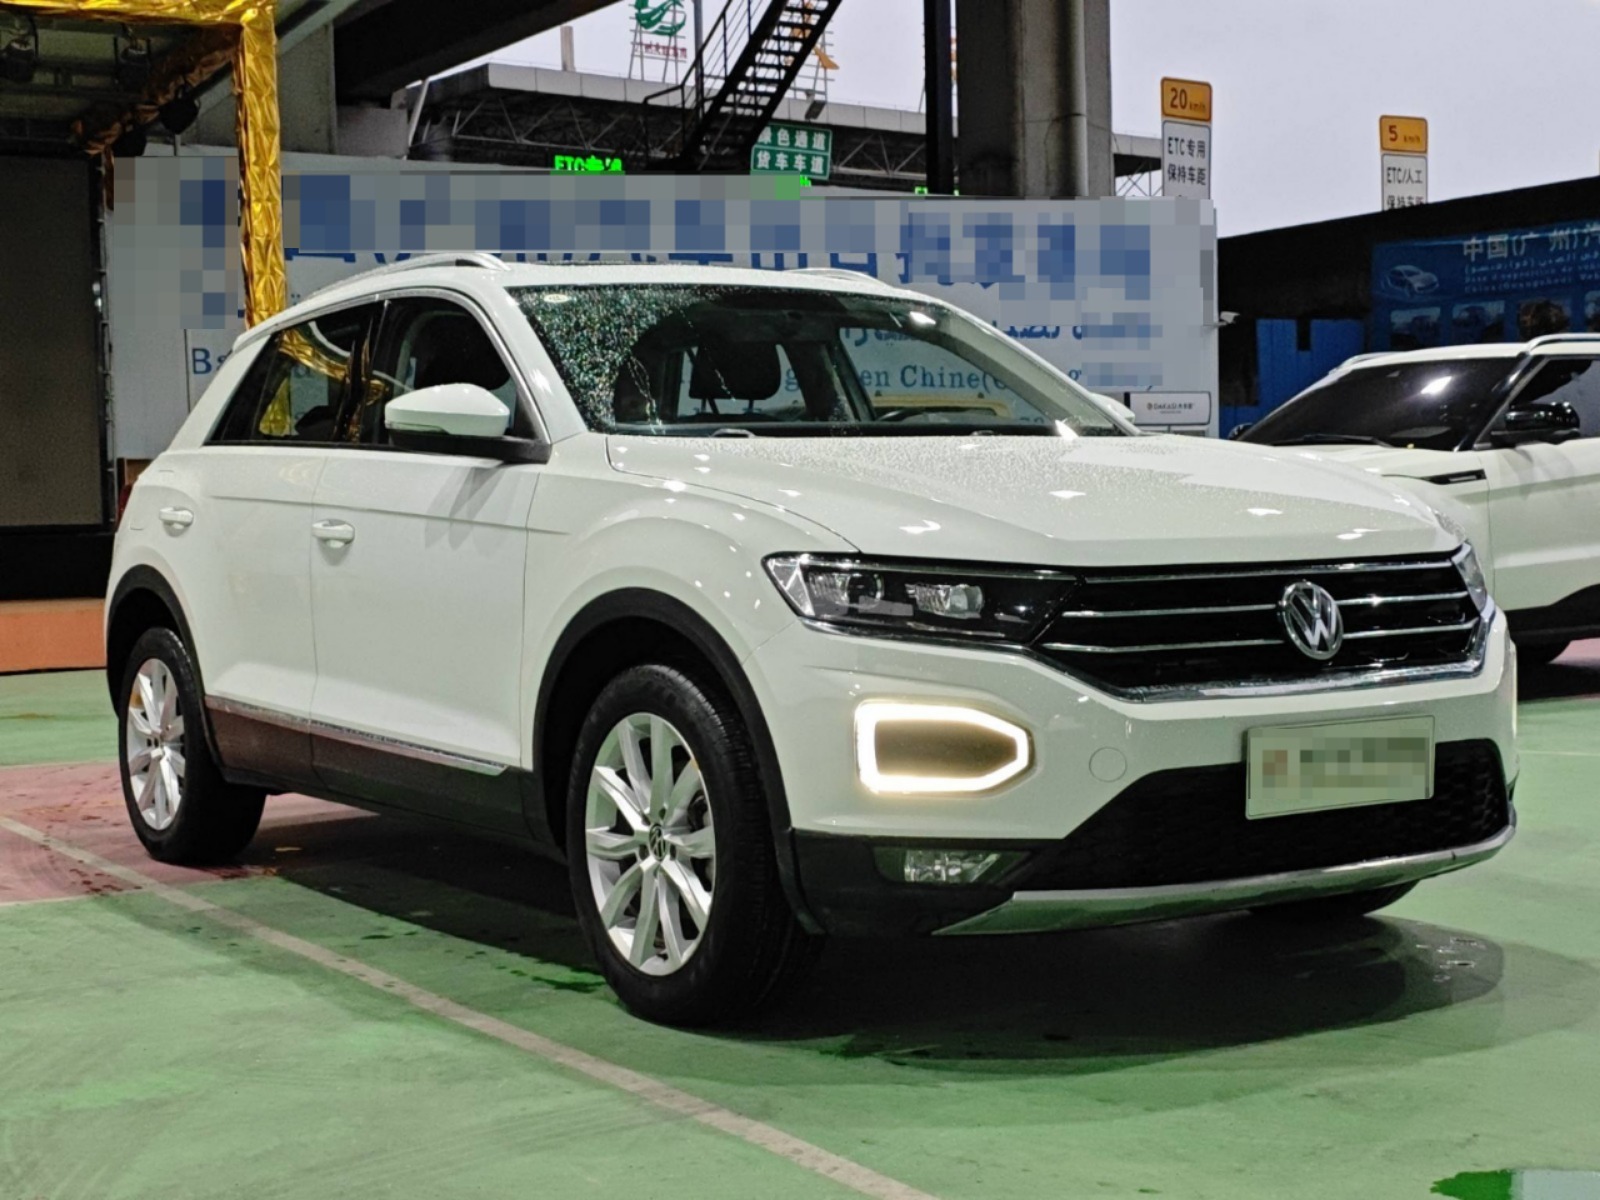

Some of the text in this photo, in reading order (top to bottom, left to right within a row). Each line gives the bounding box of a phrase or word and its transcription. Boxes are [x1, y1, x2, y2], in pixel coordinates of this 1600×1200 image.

[1169, 86, 1188, 110] 20
[1388, 124, 1399, 142] 5
[1167, 136, 1206, 159] ETC专用
[757, 150, 824, 174] 货车车道
[1167, 163, 1206, 185] 保持车距
[1386, 166, 1423, 184] ETC/人工
